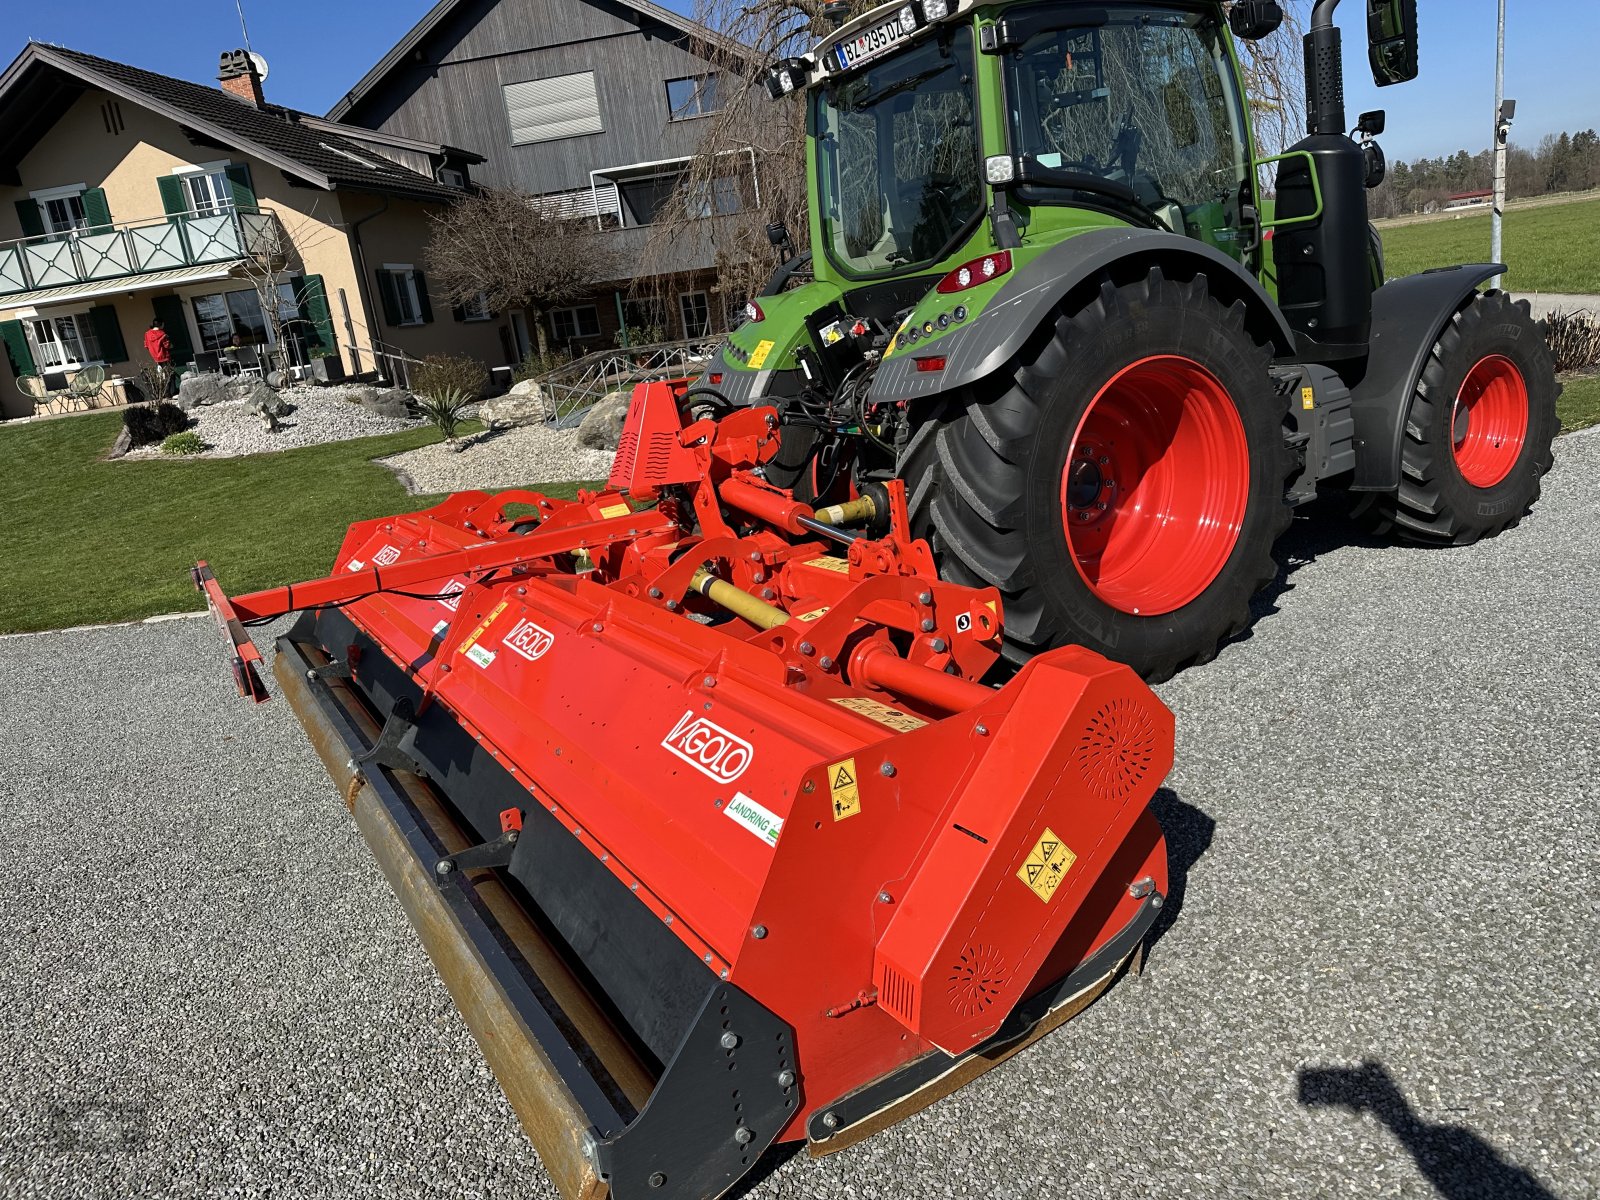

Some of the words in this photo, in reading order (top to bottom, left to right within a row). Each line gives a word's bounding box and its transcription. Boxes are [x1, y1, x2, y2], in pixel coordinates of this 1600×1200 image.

[845, 40, 861, 62] BZ
[865, 26, 887, 52] 295
[887, 18, 903, 41] DZ
[502, 618, 554, 661] VIGOLO
[661, 710, 754, 784] VIGOLO
[729, 798, 770, 832] LANDRING
